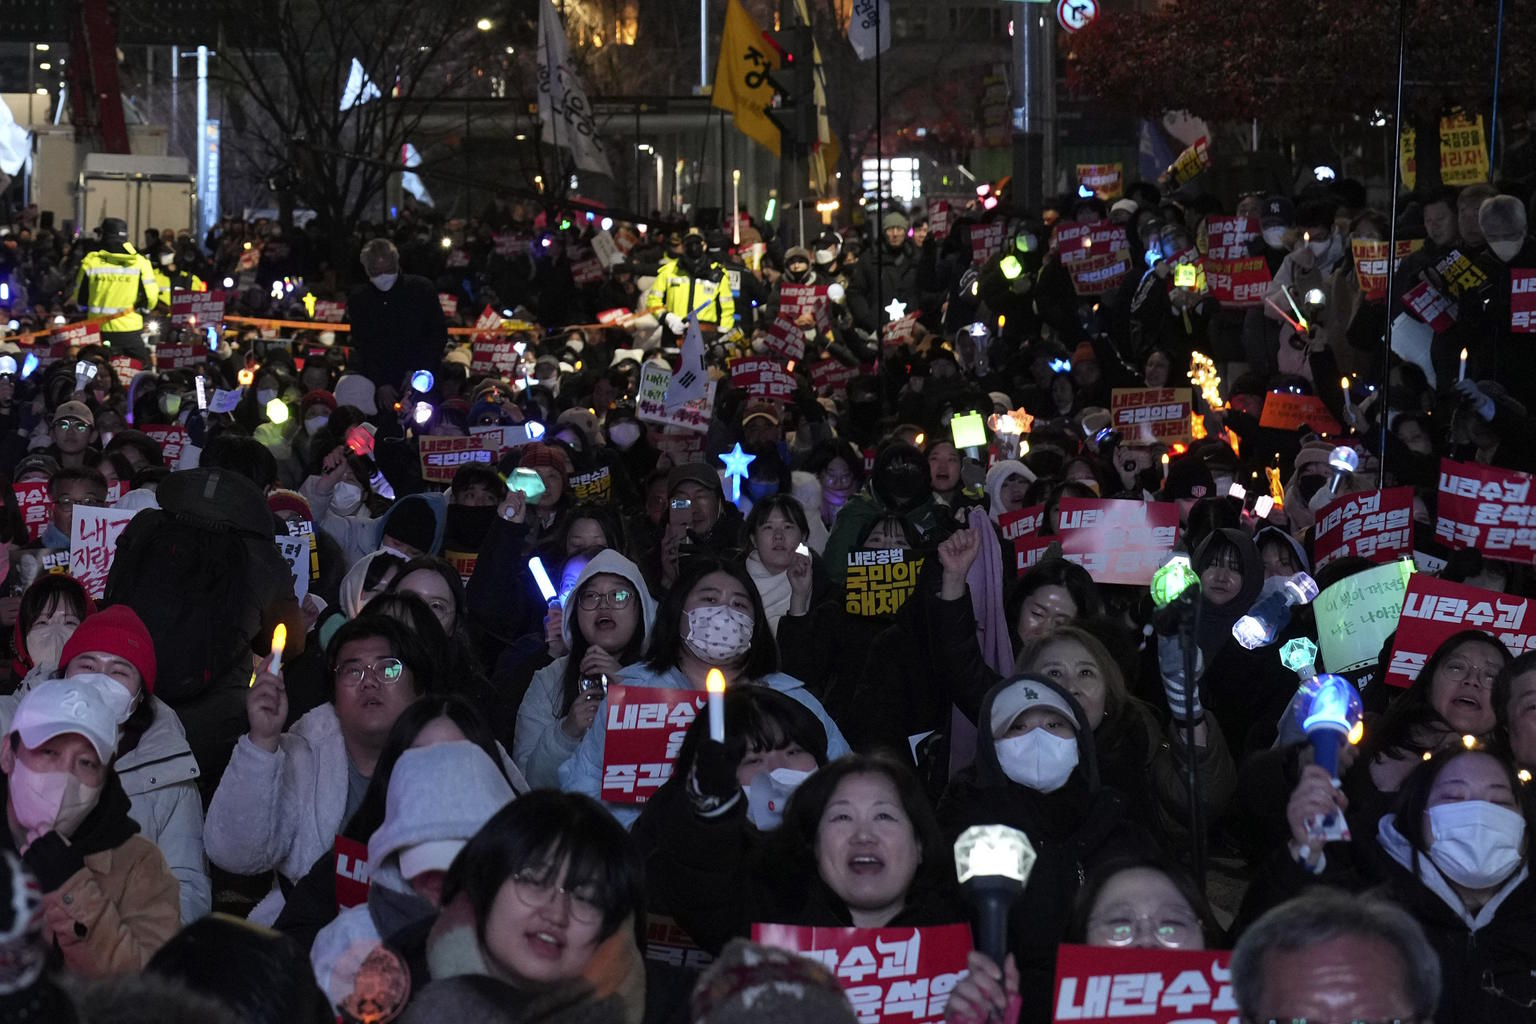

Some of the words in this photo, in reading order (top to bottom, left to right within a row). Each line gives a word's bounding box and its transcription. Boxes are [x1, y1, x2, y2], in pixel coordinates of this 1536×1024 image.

[1208, 217, 1248, 235] 내란수괴
[94, 275, 131, 283] POLICE
[731, 361, 781, 377] 내란수괴
[1119, 404, 1183, 425] 국민의힘
[421, 439, 483, 453] 내란동조
[426, 451, 492, 466] 국민의힘
[1435, 470, 1528, 506] 내란수괴
[1002, 511, 1043, 540] 내란
[1315, 491, 1382, 542] 내란수괴
[1341, 507, 1412, 544] 윤석열
[1355, 528, 1411, 559] 탄핵!
[1432, 516, 1479, 545] 즉각
[1481, 525, 1536, 552] 탄핵
[846, 552, 905, 570] 내란공범
[845, 588, 914, 617] 해체
[1404, 592, 1528, 629] 내란수괴
[1388, 650, 1428, 682] 즉
[602, 761, 674, 793] 즉각
